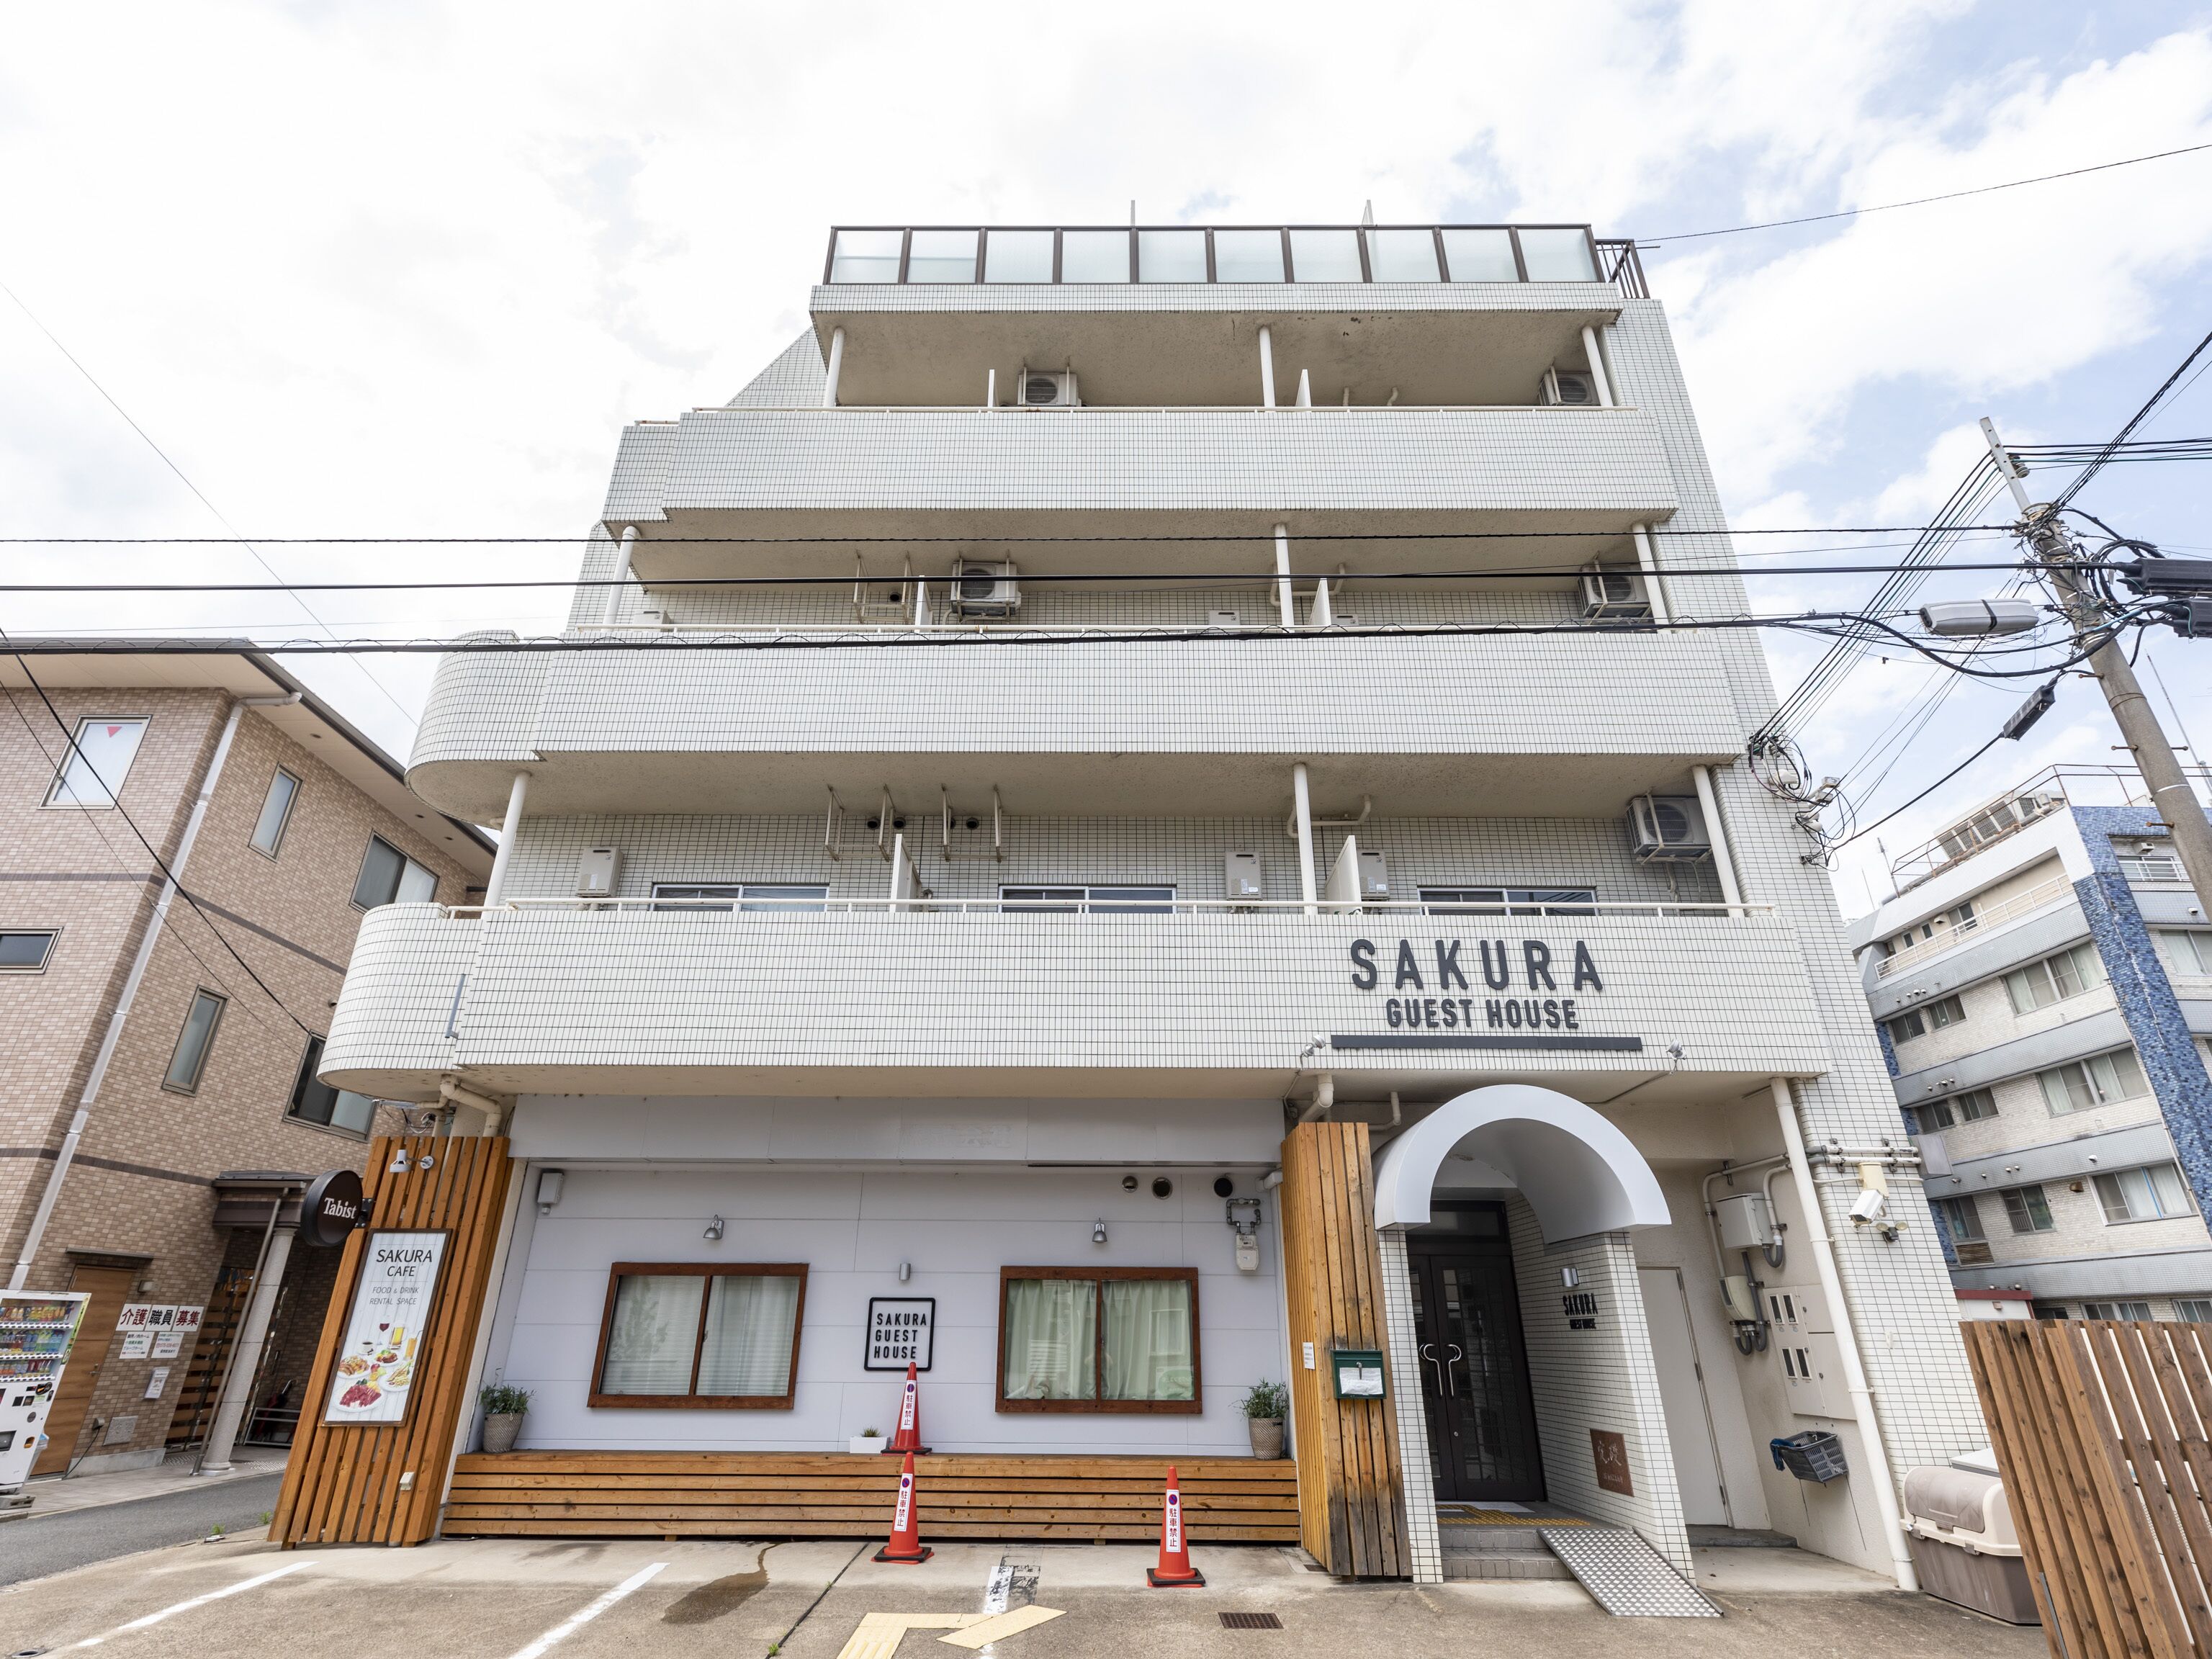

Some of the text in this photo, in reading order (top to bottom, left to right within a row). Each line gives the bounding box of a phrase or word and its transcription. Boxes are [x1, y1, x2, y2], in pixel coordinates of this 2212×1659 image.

[1350, 938, 1604, 991] SAKURA
[1386, 998, 1579, 1029] GUEST HOUSE
[323, 1197, 356, 1219] Tabist
[376, 1249, 432, 1262] SAKURA
[387, 1266, 415, 1277] CAFE
[1563, 1293, 1598, 1316] SAKURA
[120, 1308, 200, 1326] 介護職員募集
[876, 1313, 927, 1326] SAKURA
[875, 1329, 918, 1342] GUEST
[873, 1346, 917, 1359] HOUSE
[904, 1395, 913, 1426] 駐車禁止
[897, 1491, 908, 1527] 駐車禁止
